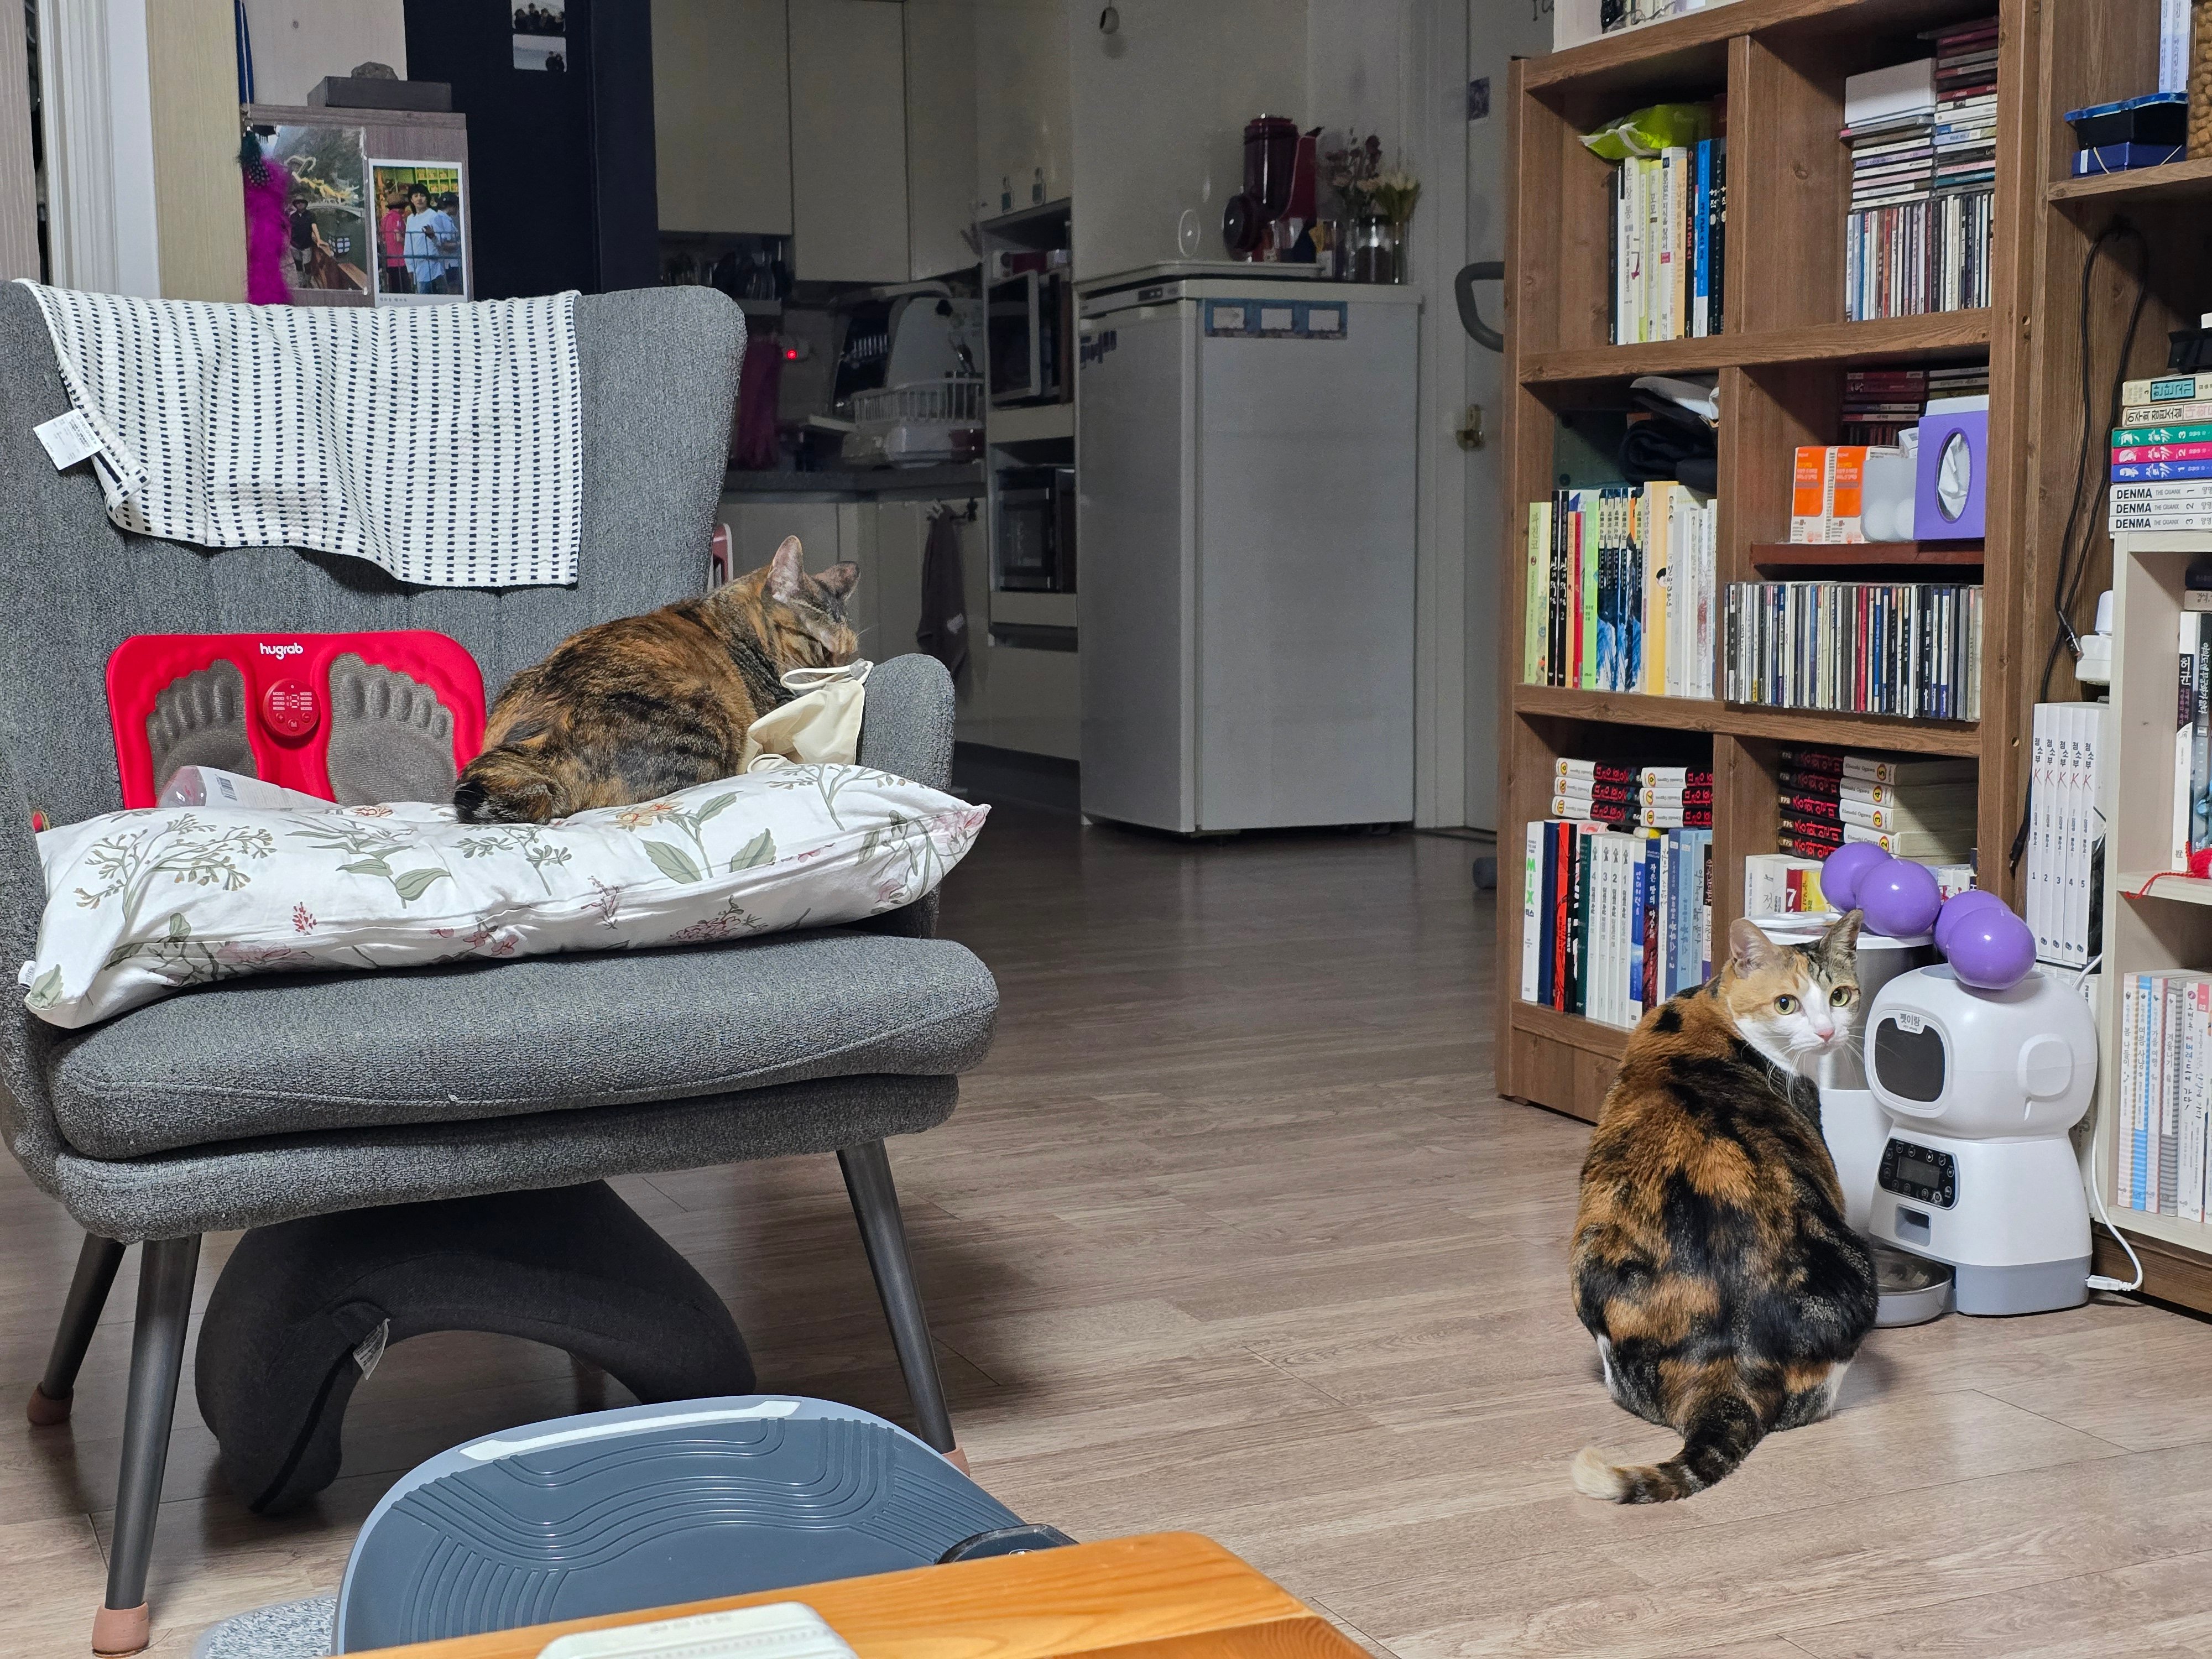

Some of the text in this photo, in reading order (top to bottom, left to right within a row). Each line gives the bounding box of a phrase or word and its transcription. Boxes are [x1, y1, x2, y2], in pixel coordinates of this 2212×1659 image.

[1650, 194, 1657, 213] 모모
[2117, 488, 2152, 499] DENMA
[2116, 503, 2152, 514] DENMA
[1530, 513, 1539, 550] 파친코
[2116, 518, 2151, 529] DENMA
[1551, 611, 1553, 619] 1
[1560, 611, 1565, 620] 2
[259, 642, 304, 660] hugrab
[2180, 656, 2192, 686] 허균
[2198, 700, 2208, 714] 없다
[2033, 768, 2042, 785] K
[2045, 770, 2054, 787] K
[2058, 771, 2067, 790] K
[2070, 773, 2080, 791] K
[2083, 774, 2093, 792] K
[1793, 795, 1838, 818] 중화일미
[1794, 820, 1841, 842] 중화일미
[1526, 858, 1536, 905] MiX
[1592, 872, 1596, 880] 4
[1603, 872, 1607, 881] 3
[1613, 873, 1617, 883] 2
[1623, 875, 1626, 884] 1
[1650, 863, 1657, 883] 작은
[1650, 885, 1656, 905] 땅의
[1525, 909, 1534, 917] 믹스
[1693, 924, 1702, 943] 묻다
[1900, 1013, 1920, 1027] 펫이랑
[2124, 1027, 2130, 1037] 봄
[2138, 1026, 2146, 1046] 여름
[2152, 1030, 2158, 1047] 가을
[2151, 1050, 2158, 1068] 여행
[2166, 1033, 2174, 1068] 겨울나기
[2137, 1050, 2145, 1070] 사냥
[2195, 1100, 2203, 1119] 가다
